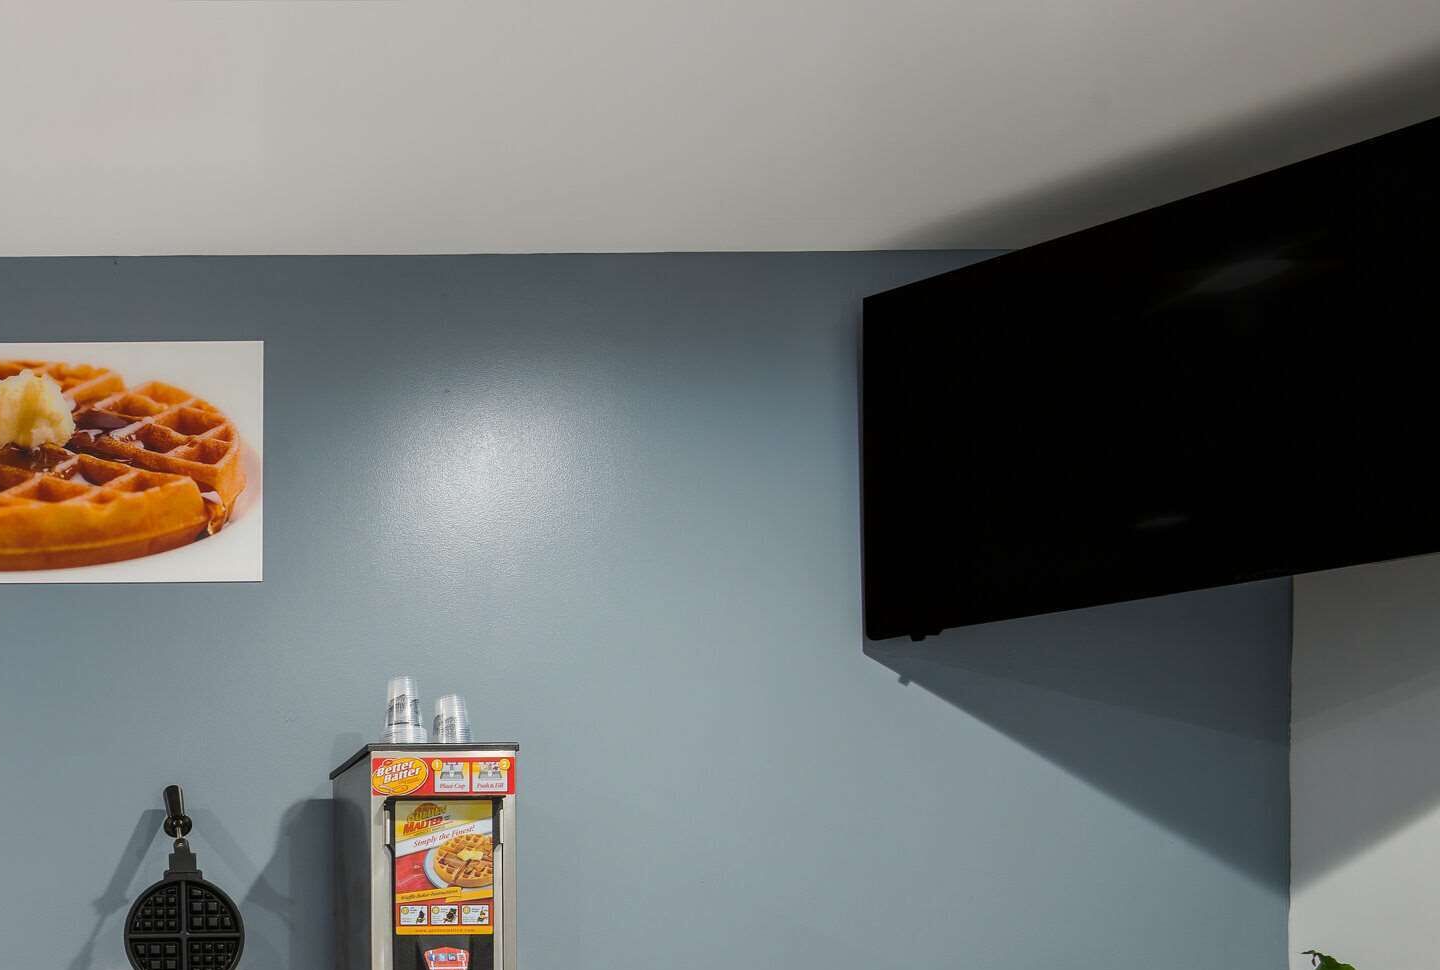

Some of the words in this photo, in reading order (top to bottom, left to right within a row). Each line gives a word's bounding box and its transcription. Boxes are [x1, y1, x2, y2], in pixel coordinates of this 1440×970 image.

[376, 760, 414, 777] Better
[383, 766, 420, 785] Batter
[413, 834, 437, 848] Simply
[438, 832, 450, 841] the
[451, 824, 476, 837] Finest!
